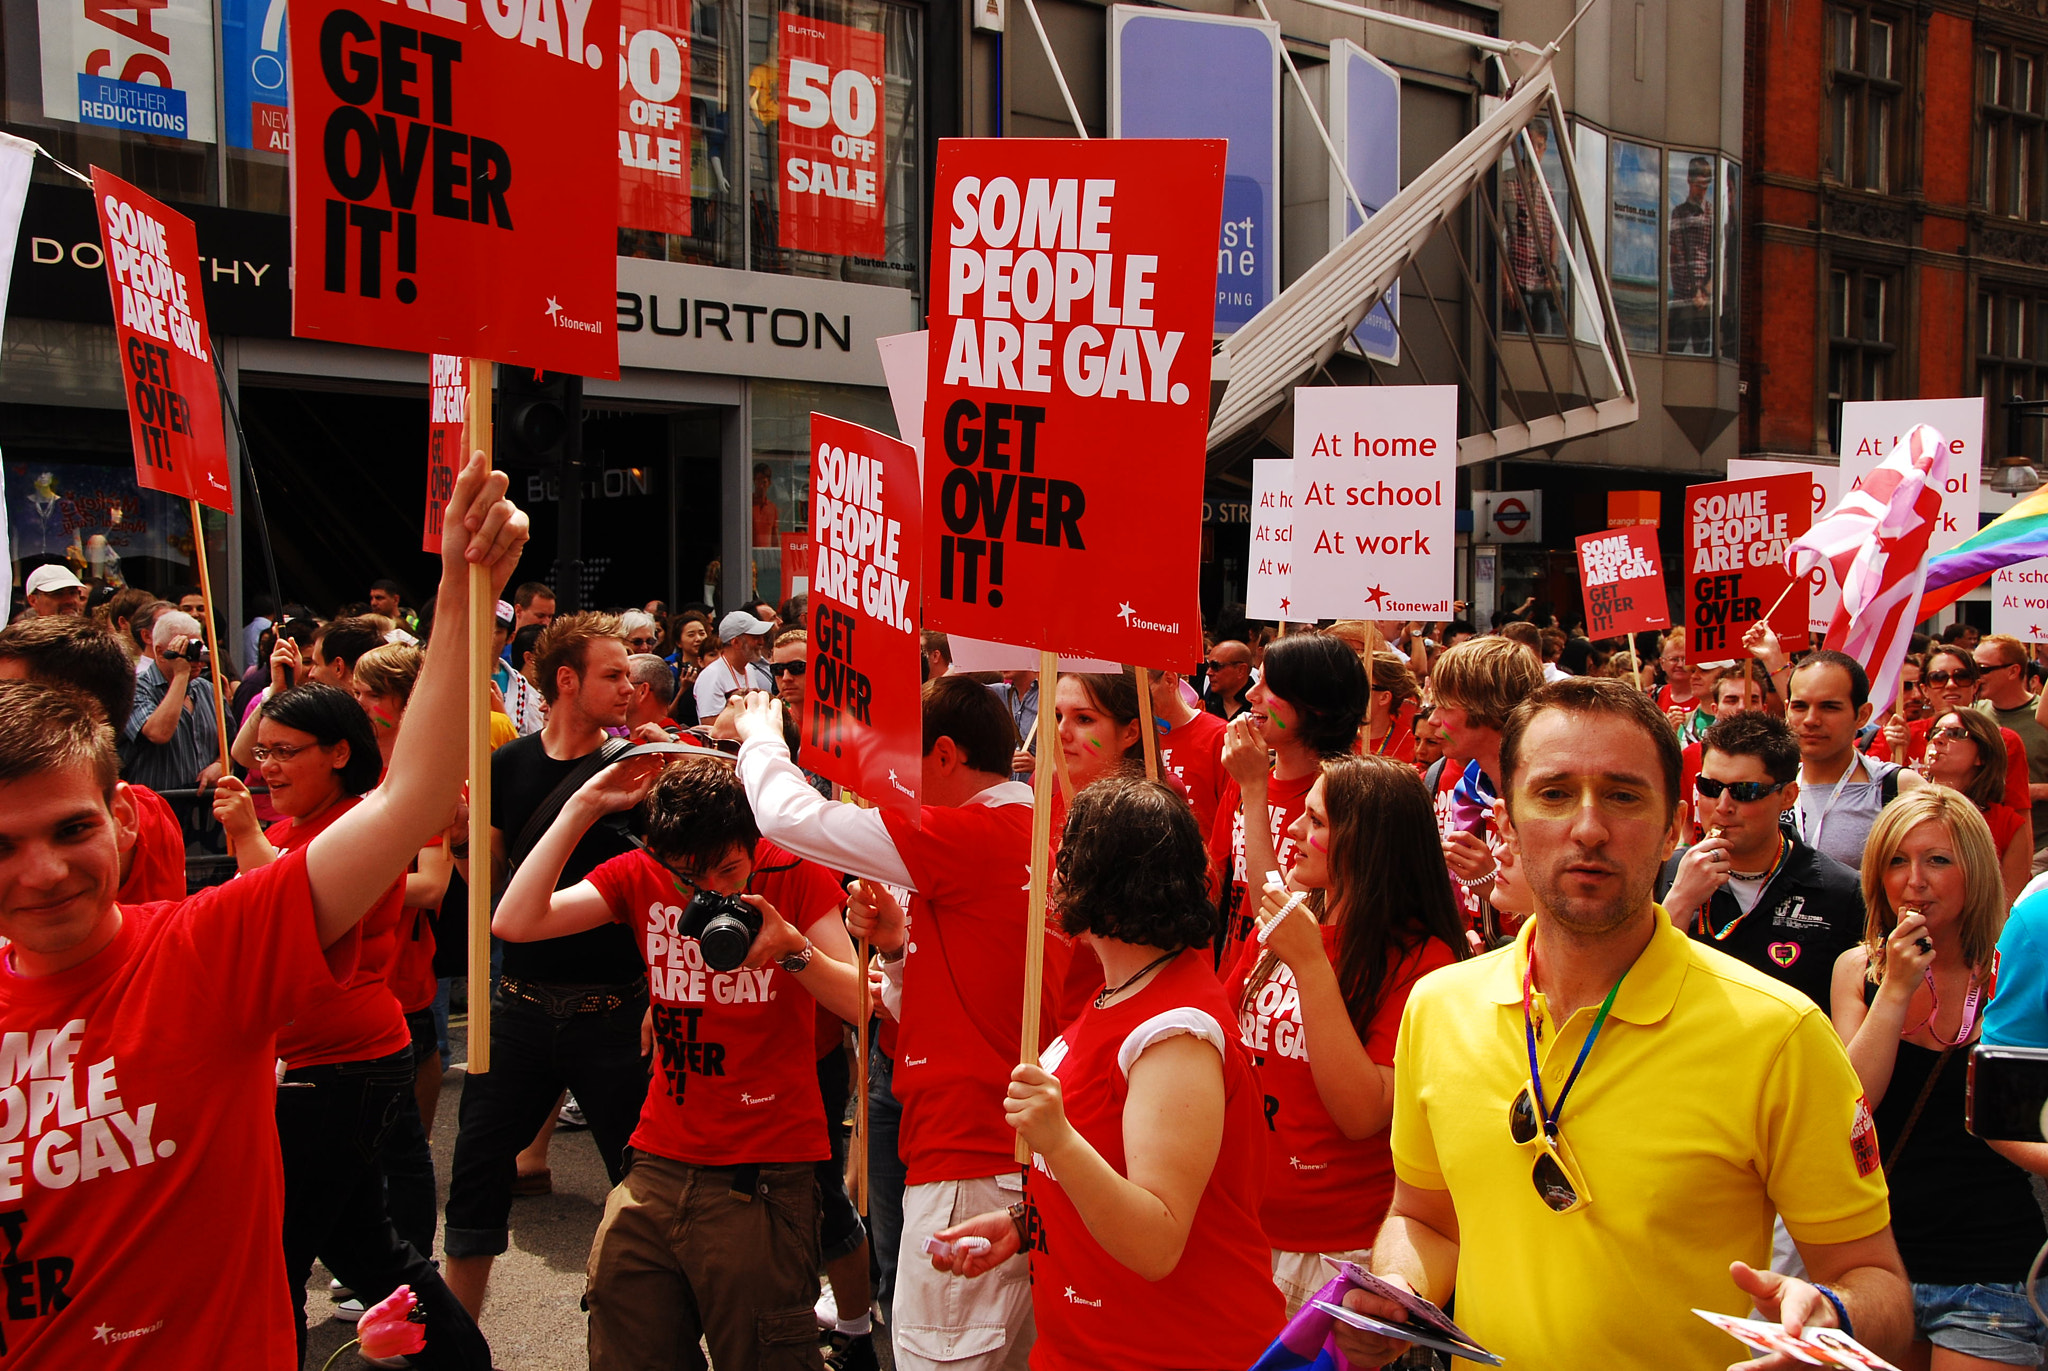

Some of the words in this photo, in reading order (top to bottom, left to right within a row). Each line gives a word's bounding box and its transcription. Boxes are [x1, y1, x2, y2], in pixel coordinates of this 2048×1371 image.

[788, 24, 826, 40] BURTON
[320, 9, 462, 127] GET
[619, 26, 687, 103] 0%
[100, 85, 166, 111] FURTHER
[82, 100, 185, 132] REDUCTIONS
[629, 99, 681, 131] OFF
[831, 134, 876, 163] OFF
[324, 105, 514, 231] OVER
[787, 157, 877, 204] SALE
[950, 176, 1116, 251] SOME
[104, 194, 170, 267] SOME
[31, 236, 271, 287] DOHY
[324, 198, 418, 304] IT!
[854, 256, 916, 273] burton.co.uk
[110, 239, 190, 316] PEOPLE
[948, 247, 1159, 328] PEOPLE
[121, 284, 170, 342] ARE
[168, 304, 208, 363] GAY.
[559, 314, 602, 335] Stonewall
[617, 290, 851, 353] BURTON
[128, 336, 171, 389] GET
[432, 353, 462, 387] PEOPLE
[943, 318, 1053, 393] ARE
[1062, 324, 1190, 405] GAY.
[134, 380, 195, 440] OVER
[141, 422, 174, 473] IT!
[943, 398, 1046, 474] GET
[1311, 432, 1342, 457] At
[1353, 431, 1437, 457] home
[1856, 437, 1882, 457] At
[527, 466, 648, 502] BUON
[816, 442, 883, 515] SOME
[1304, 481, 1335, 506] At
[1346, 480, 1442, 507] school
[941, 467, 1086, 551] OVER
[1260, 491, 1275, 508] At
[1693, 489, 1767, 523] SOME
[815, 494, 901, 573] PEOPLE
[1256, 524, 1270, 541] At
[1609, 518, 1636, 526] orange
[1693, 513, 1788, 548] PEOPLE
[1314, 530, 1345, 554] At
[1355, 530, 1431, 555] work
[1581, 535, 1630, 558] SOME
[1692, 543, 1744, 574] ARE
[940, 535, 1004, 608] IT!
[1258, 558, 1272, 575] At
[1583, 547, 1645, 573] PEOPLE
[1586, 566, 1619, 587] ARE
[1620, 560, 1658, 580] GAY.
[1998, 569, 2013, 582] At
[814, 545, 858, 610] ARE
[861, 564, 913, 635] GAY.
[1589, 583, 1618, 602] GET
[1694, 573, 1742, 602] GET
[2003, 594, 2019, 608] At
[1386, 600, 1448, 612] Stonewall
[1591, 597, 1634, 616] OVER
[1593, 614, 1614, 631] IT!
[1695, 597, 1763, 627] OVER
[815, 603, 856, 666] GET
[1132, 617, 1179, 634] Stonewall
[1695, 625, 1726, 652] IT!
[814, 653, 872, 727] OVER
[811, 700, 843, 759] IT!
[894, 779, 915, 800] Stonewall
[651, 966, 706, 1002] ARE
[712, 968, 777, 1005] GAY.
[652, 1003, 703, 1041] GET
[33, 1103, 177, 1190] GAY.
[1073, 1295, 1102, 1308] Stonewall
[111, 1320, 163, 1344] Stonewall
